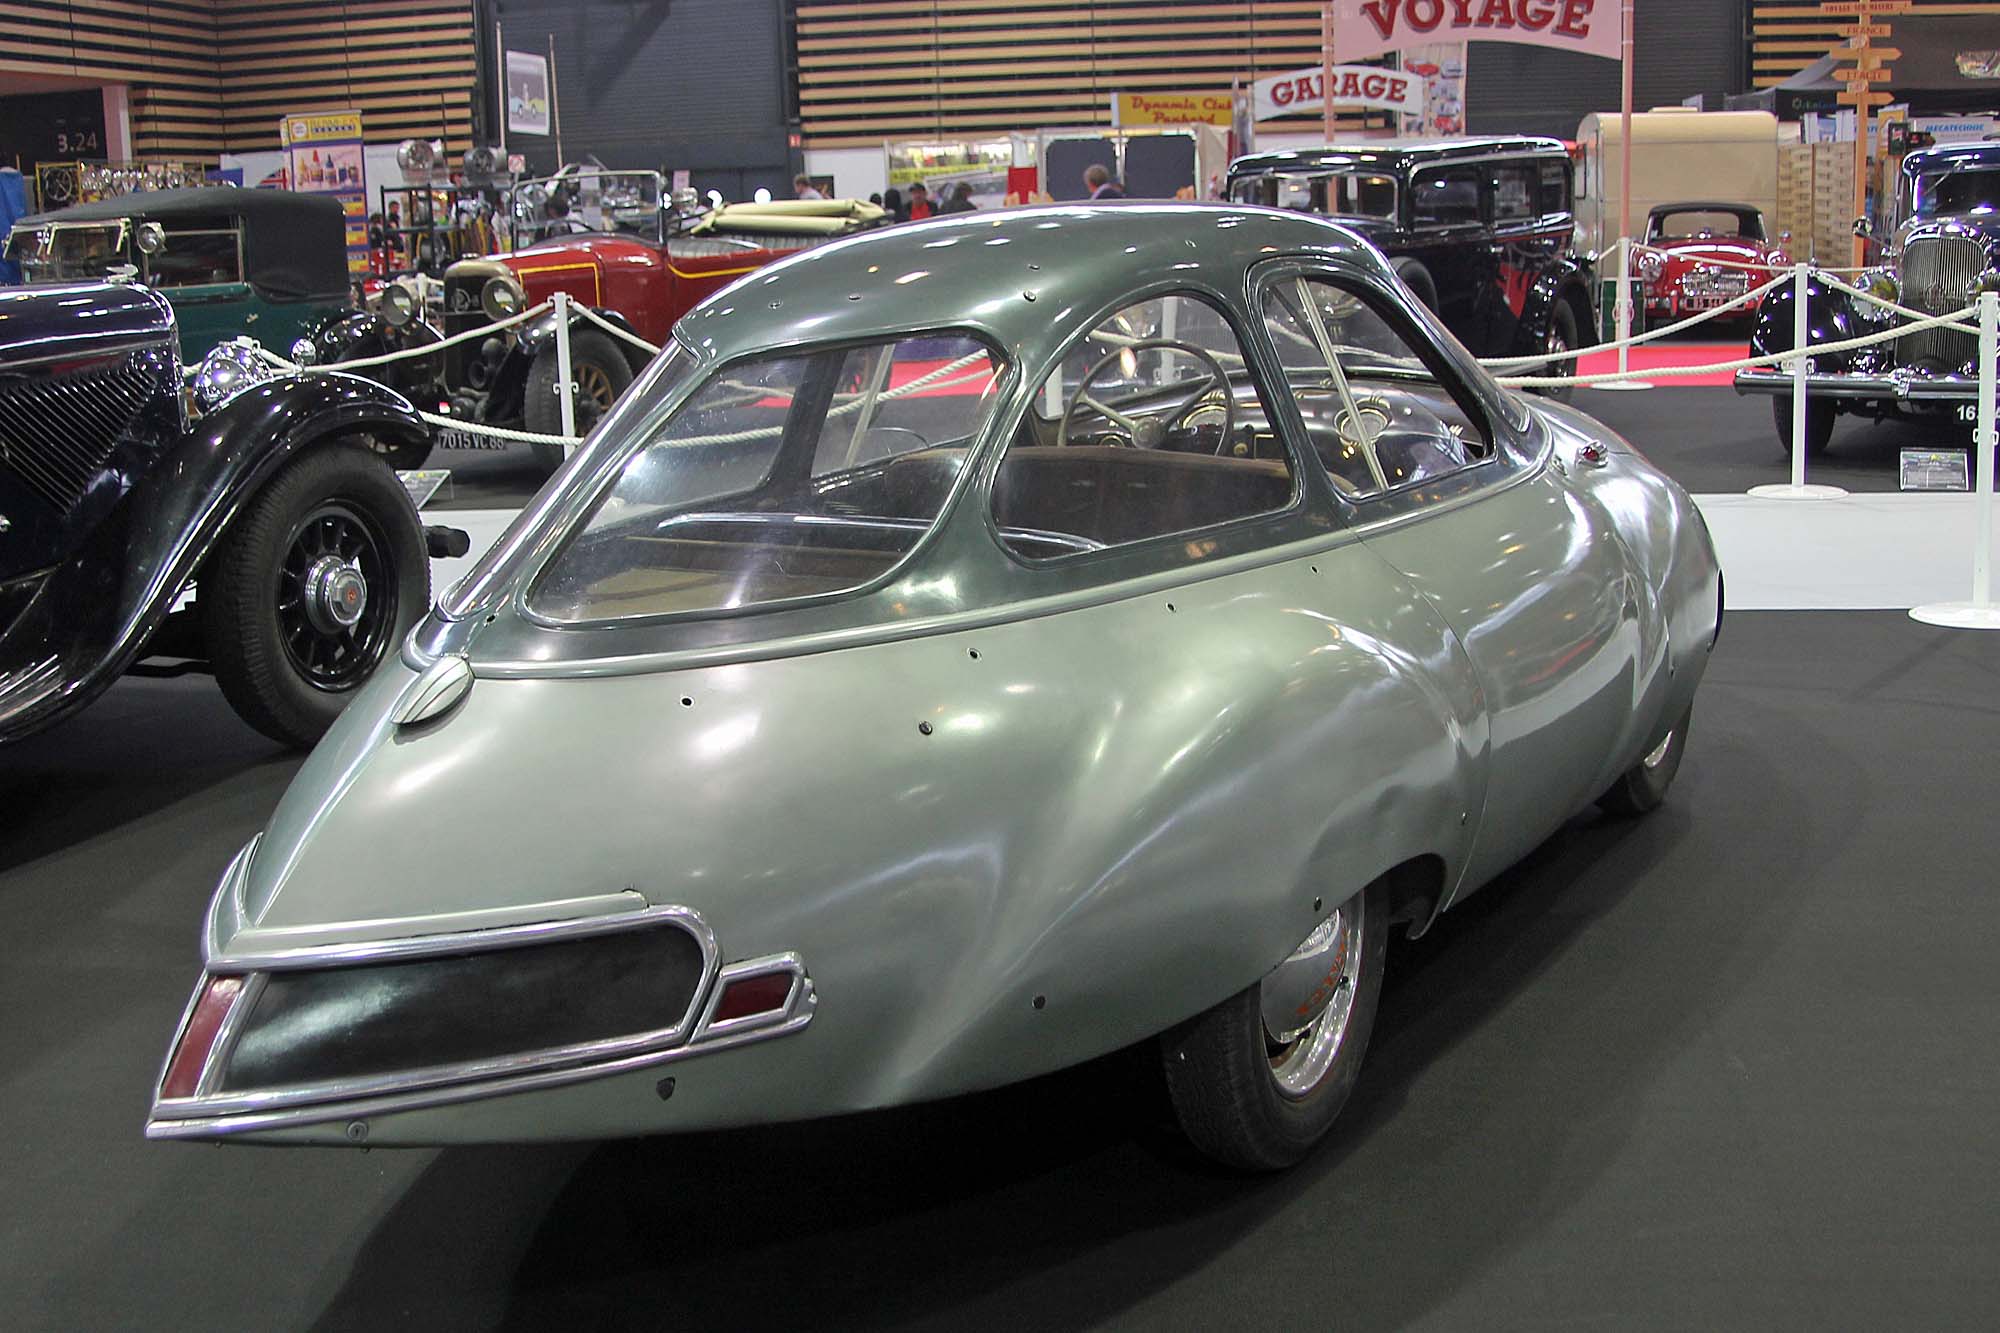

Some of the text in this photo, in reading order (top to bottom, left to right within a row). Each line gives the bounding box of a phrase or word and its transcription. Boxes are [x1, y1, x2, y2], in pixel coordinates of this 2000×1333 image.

[1359, 0, 1594, 41] VOYAGE
[1271, 73, 1408, 107] GARAGE
[57, 132, 97, 152] 3.24
